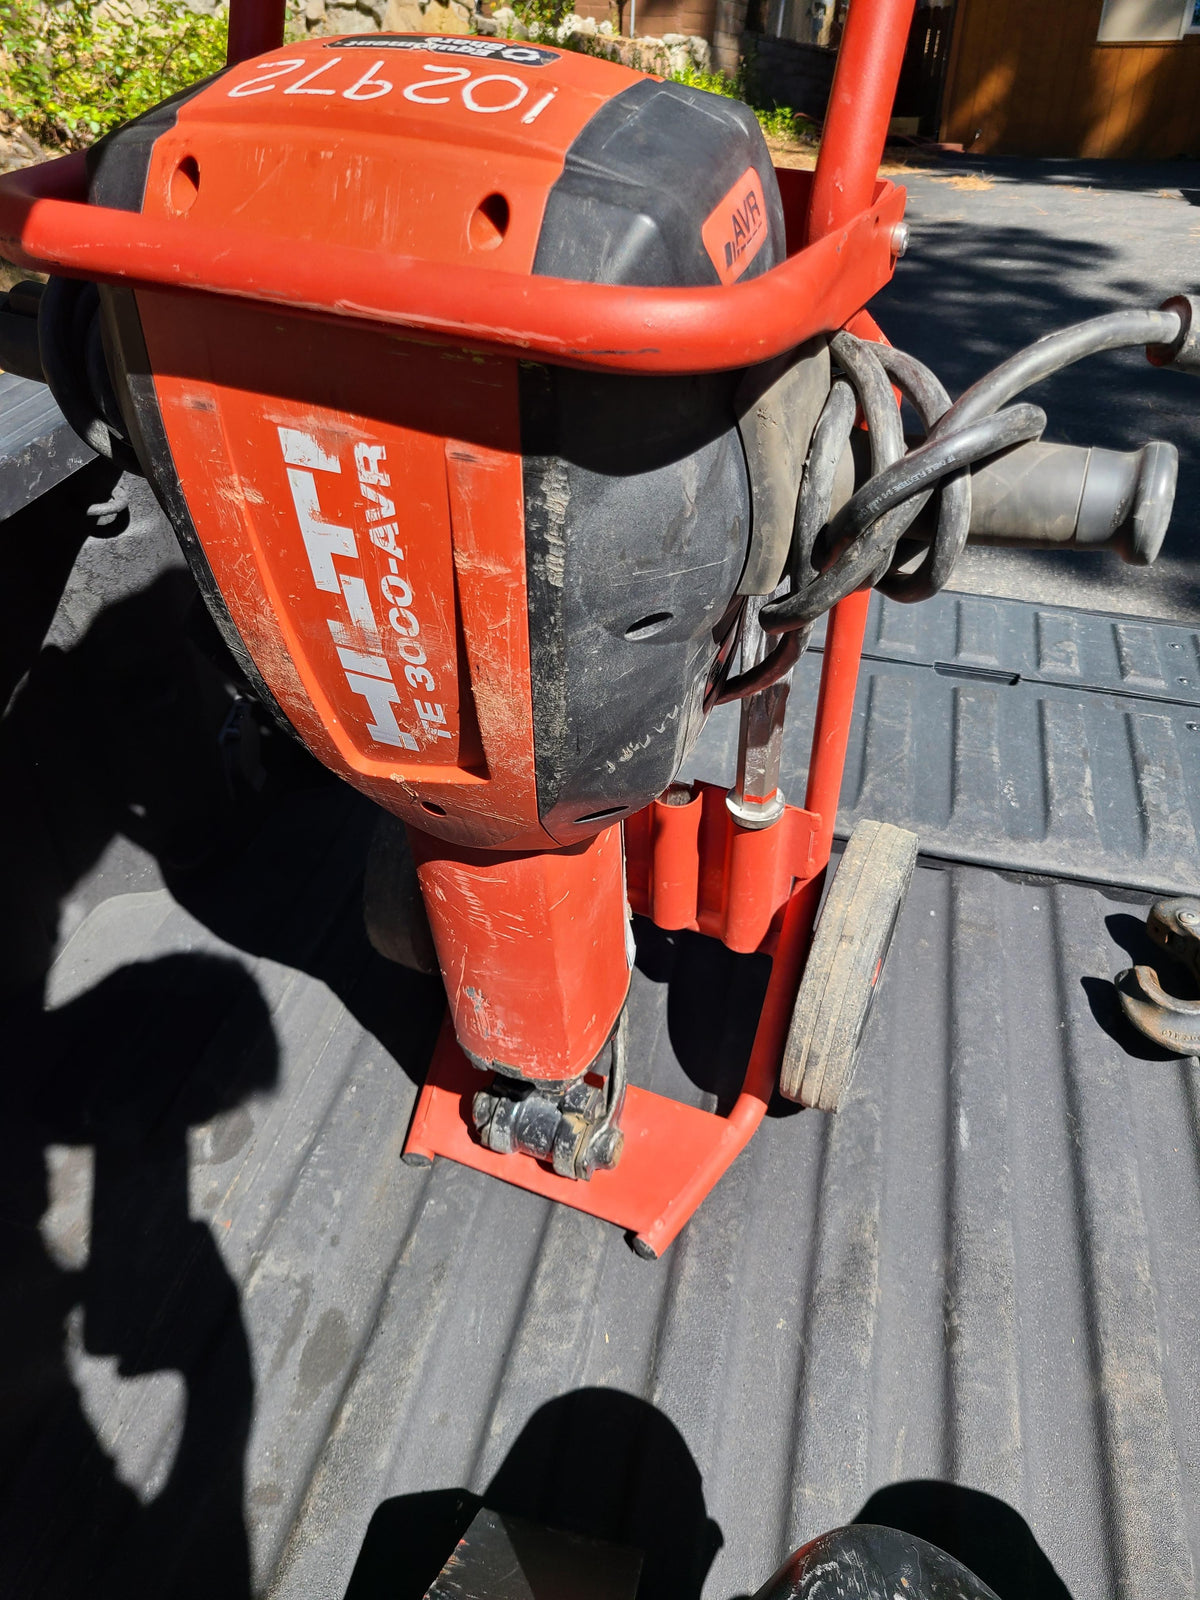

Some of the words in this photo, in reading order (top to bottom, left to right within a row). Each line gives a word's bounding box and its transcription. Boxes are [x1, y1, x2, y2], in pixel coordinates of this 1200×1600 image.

[343, 39, 496, 57] Equipment
[424, 36, 507, 50] Share
[227, 57, 559, 124] 102972
[731, 190, 761, 247] AVR
[277, 426, 420, 752] HILTI
[413, 698, 453, 739] TE
